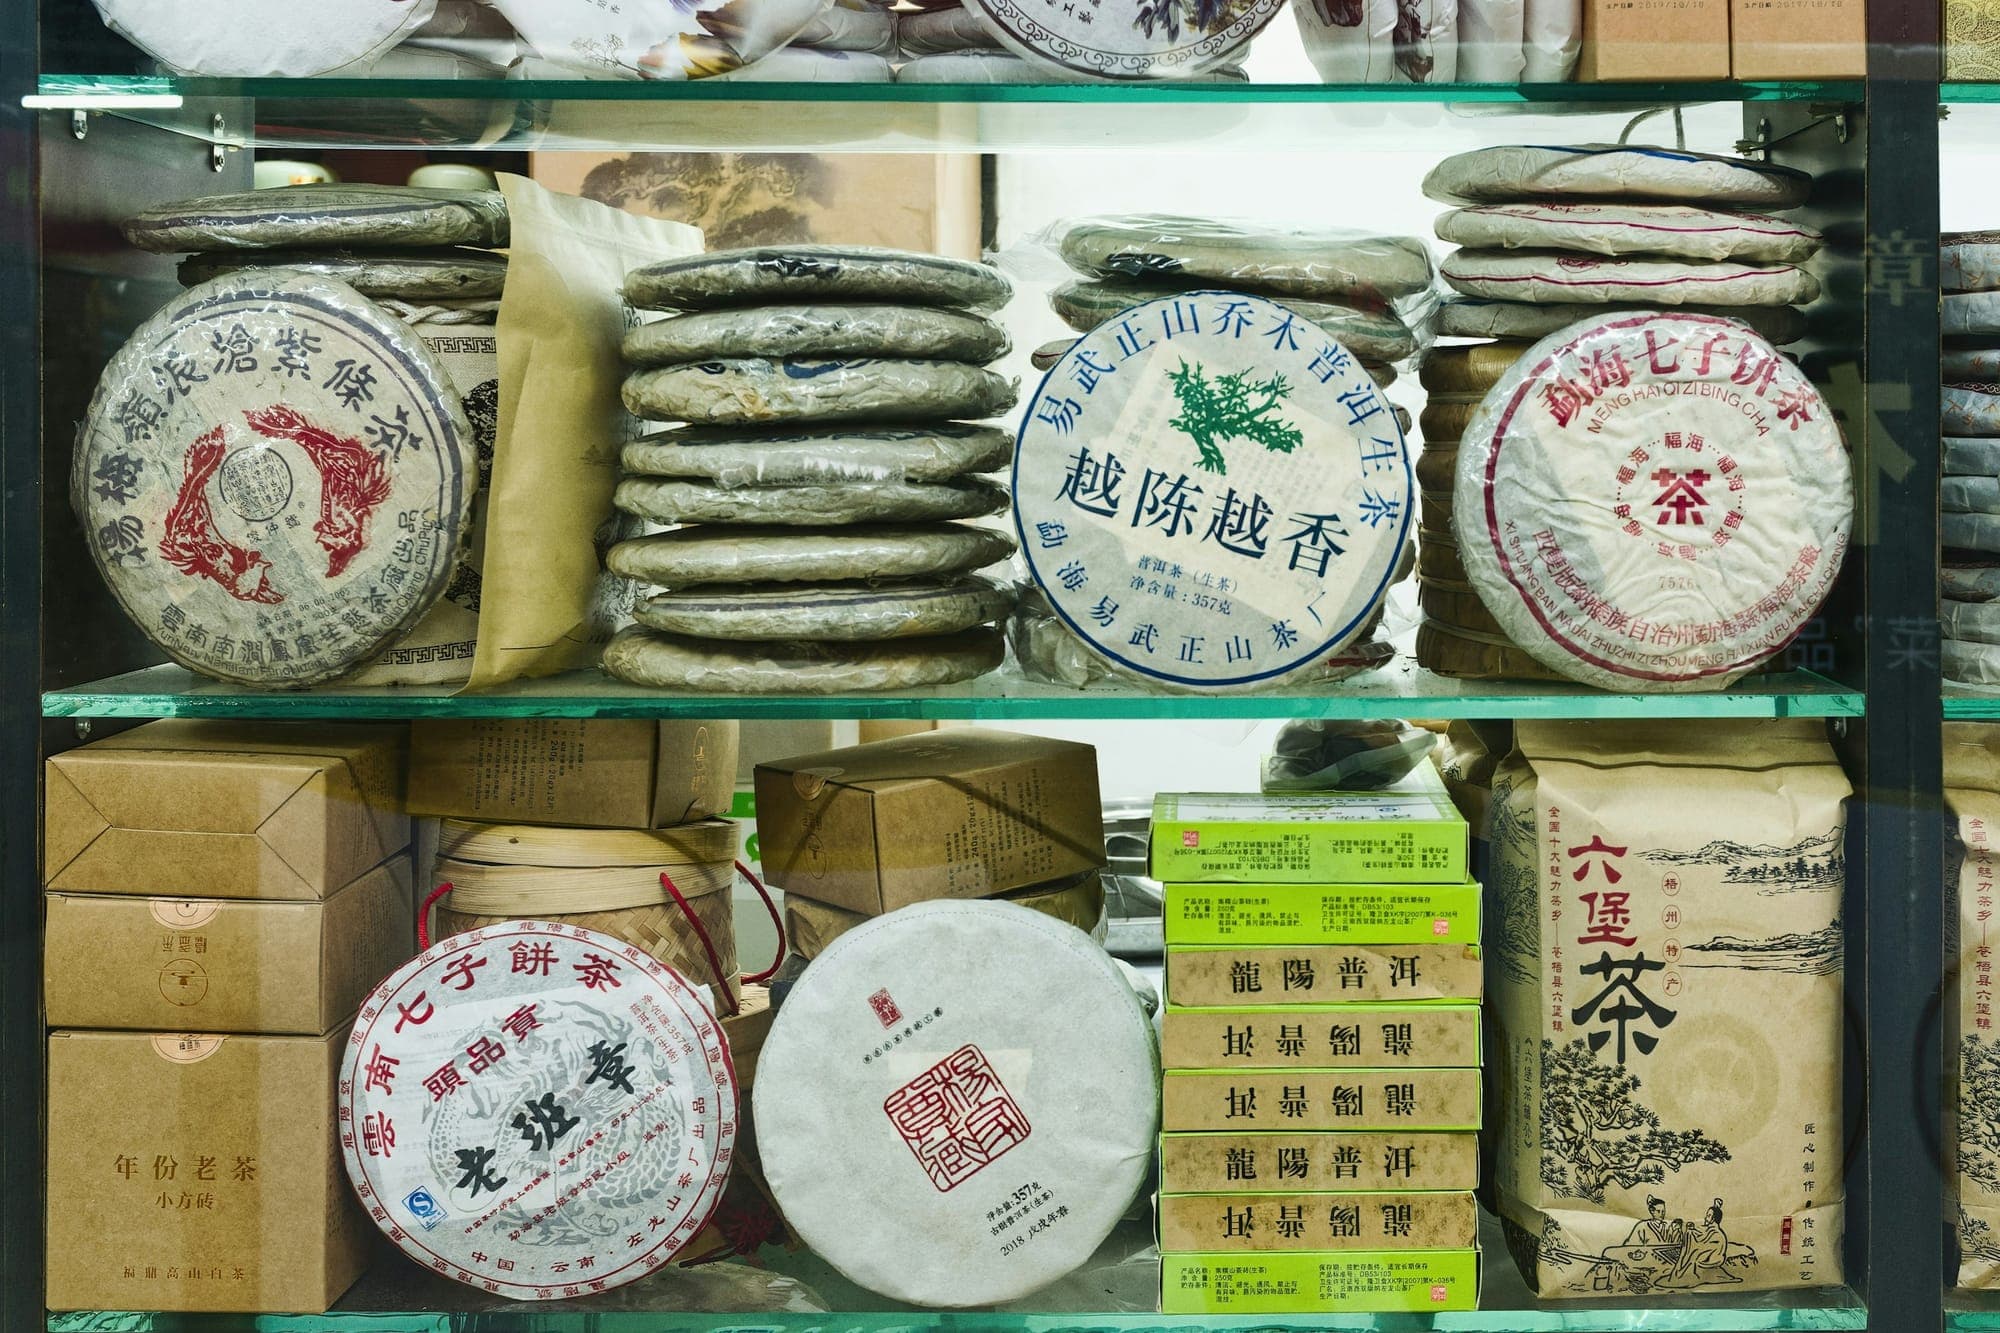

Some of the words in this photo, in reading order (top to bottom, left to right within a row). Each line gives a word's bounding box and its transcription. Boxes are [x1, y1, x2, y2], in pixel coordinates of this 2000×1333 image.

[1036, 300, 1401, 530] 易武正山乔木普洱生茶
[1586, 392, 1632, 435] MENG
[1632, 382, 1661, 402] HAI
[1737, 402, 1771, 439] CHA
[1053, 445, 1352, 579] 越陈越香
[1651, 468, 1711, 525] 茶
[1035, 519, 1327, 664] 勐海易武正山茶厂
[1567, 834, 1678, 1065] 六堡茶
[1664, 877, 1680, 991] 梧州特产
[1229, 955, 1421, 994] 龍陽普洱
[360, 940, 623, 1159] 雲南七子餅茶
[1221, 1024, 1414, 1057] 龍陽普洱
[455, 1039, 635, 1199] 老班章
[1225, 1084, 1418, 1118] 龍陽普洱
[113, 1154, 257, 1182] 年份老茶
[1225, 1146, 1416, 1181] 龍陽普洱
[154, 1191, 215, 1210] 小方砖
[1221, 1204, 1414, 1238] 龍陽普洱
[999, 1234, 1026, 1257] 2018
[124, 1266, 245, 1280] 福鼎高山白茶
